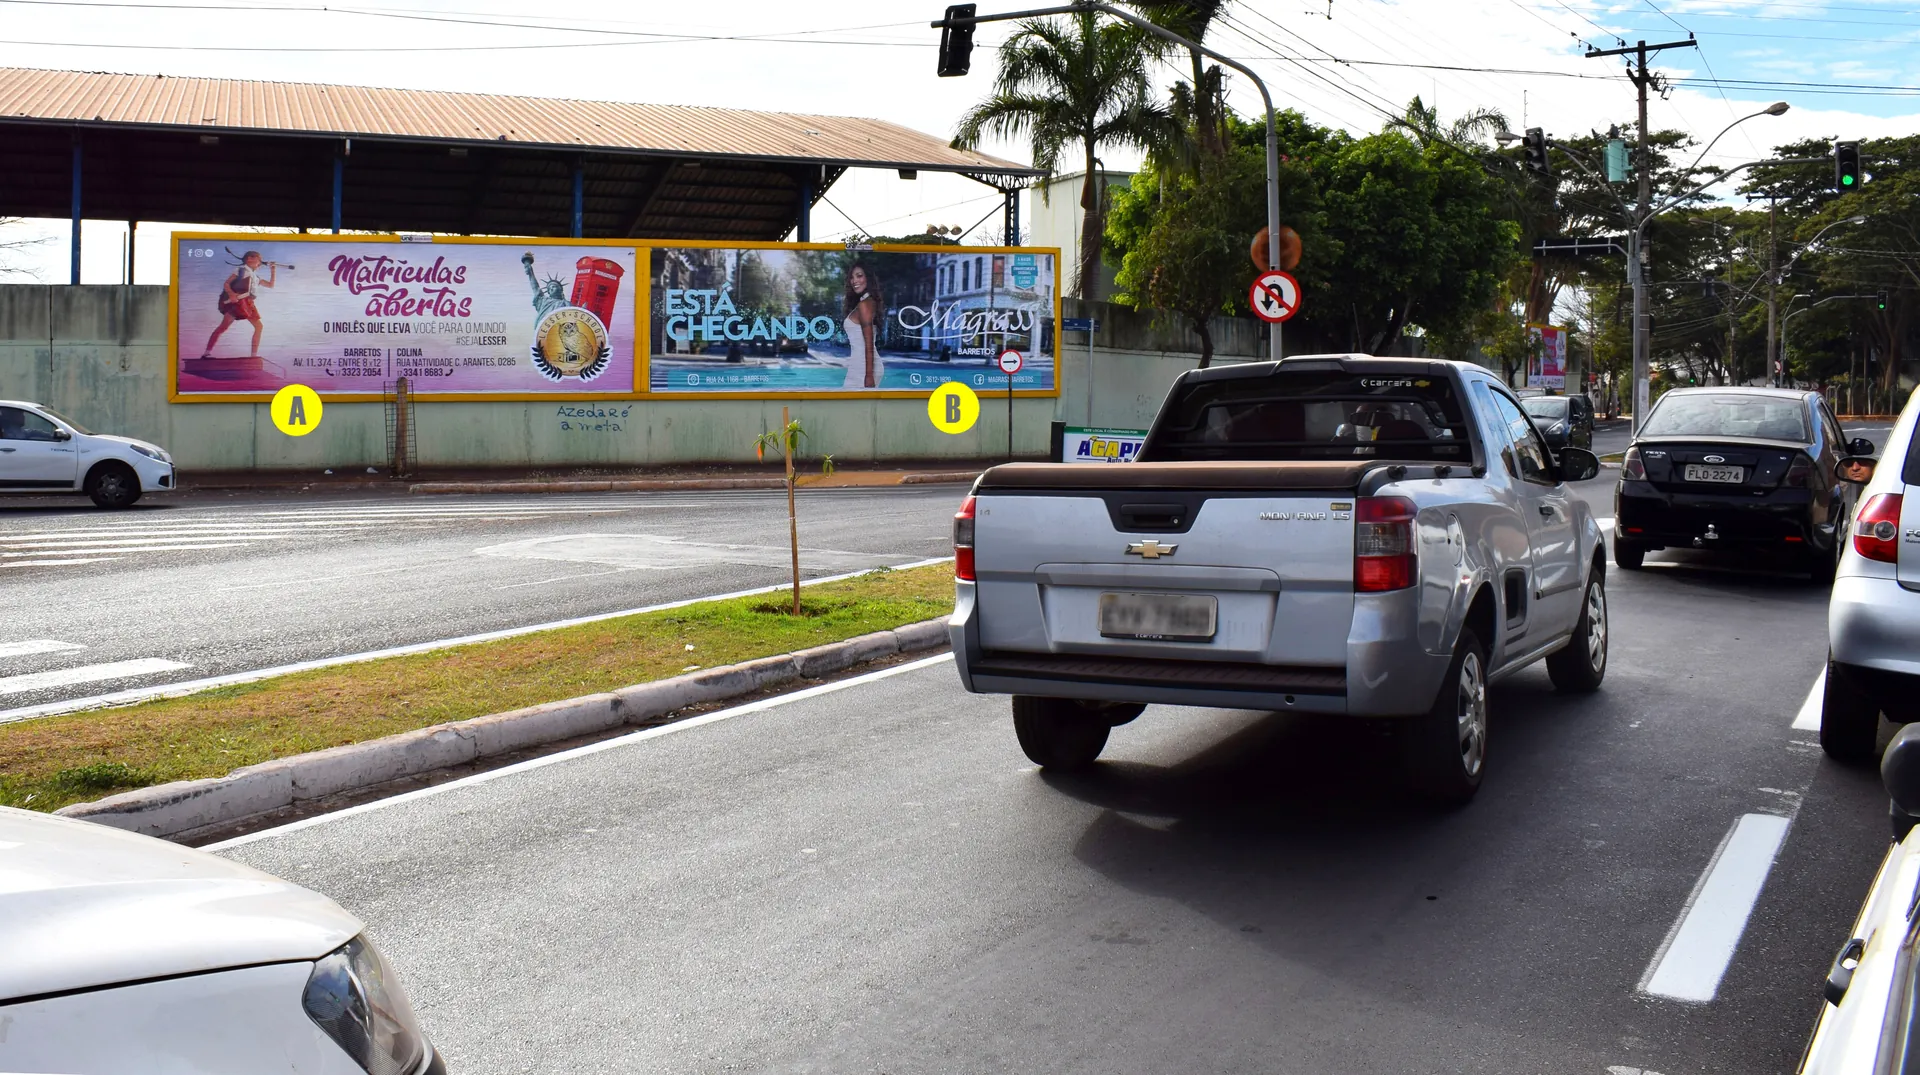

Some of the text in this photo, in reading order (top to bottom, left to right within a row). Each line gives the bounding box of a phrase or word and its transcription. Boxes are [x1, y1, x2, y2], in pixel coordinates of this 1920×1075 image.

[328, 254, 467, 295] Matrículas
[365, 286, 473, 318] abertas
[666, 281, 737, 315] ESTÁ
[323, 319, 507, 334] O INGLÊS QUE LEVA VOCÊ PARA O MUNDO!
[539, 311, 604, 340] LESSER SCHOOL
[666, 315, 835, 341] CHEGANDO
[344, 348, 382, 357] BARRETOS
[396, 348, 423, 357] COLINA
[957, 347, 996, 356] BARRETOS
[293, 358, 303, 367] AV.
[317, 358, 332, 367] 374
[338, 358, 361, 367] ENTRE
[396, 358, 411, 367] RUA
[412, 358, 453, 367] NATIVIDADE
[497, 357, 517, 366] 0285
[341, 368, 361, 377] 3323
[362, 368, 382, 377] 2054
[403, 368, 422, 377] 3341
[424, 368, 443, 377] 8683
[1332, 511, 1350, 521] LS
